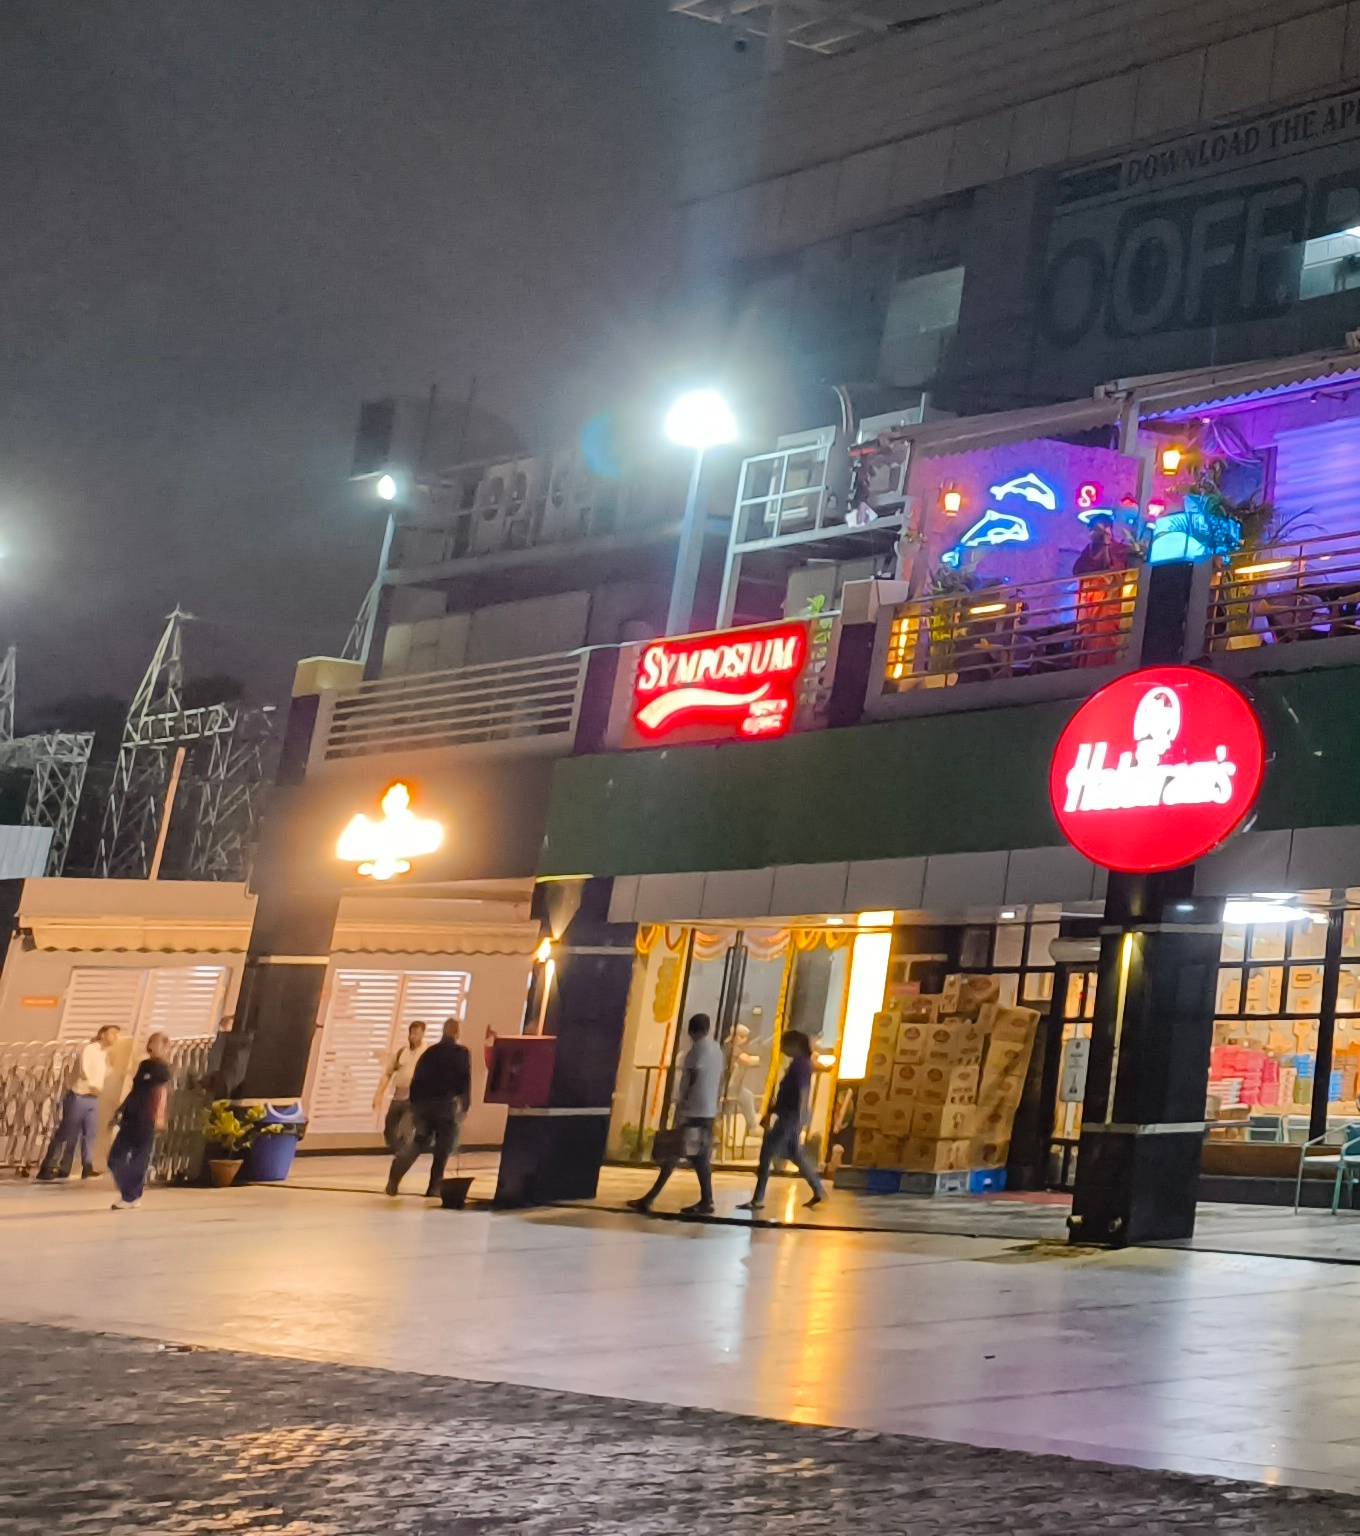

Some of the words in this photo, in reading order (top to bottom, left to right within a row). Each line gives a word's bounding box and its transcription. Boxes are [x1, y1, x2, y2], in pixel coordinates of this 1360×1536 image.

[1127, 126, 1261, 188] DOWNLOAD
[1267, 109, 1321, 148] THE
[637, 635, 799, 691] SYMPOSIUM
